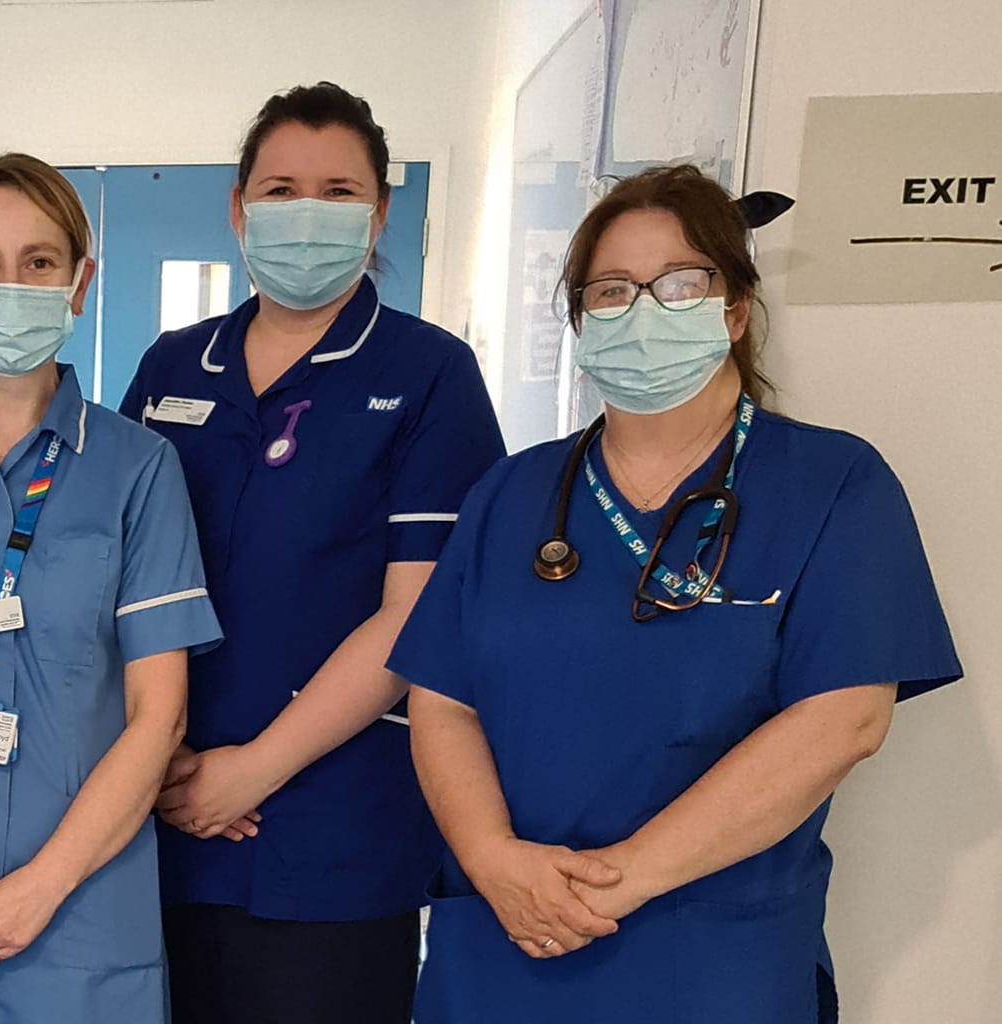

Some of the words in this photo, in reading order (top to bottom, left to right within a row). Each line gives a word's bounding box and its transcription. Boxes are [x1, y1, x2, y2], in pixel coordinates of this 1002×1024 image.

[902, 177, 996, 205] EXIT
[368, 397, 400, 411] NHS
[740, 401, 754, 427] NHS
[595, 488, 613, 512] NHS
[610, 512, 632, 537] NHS
